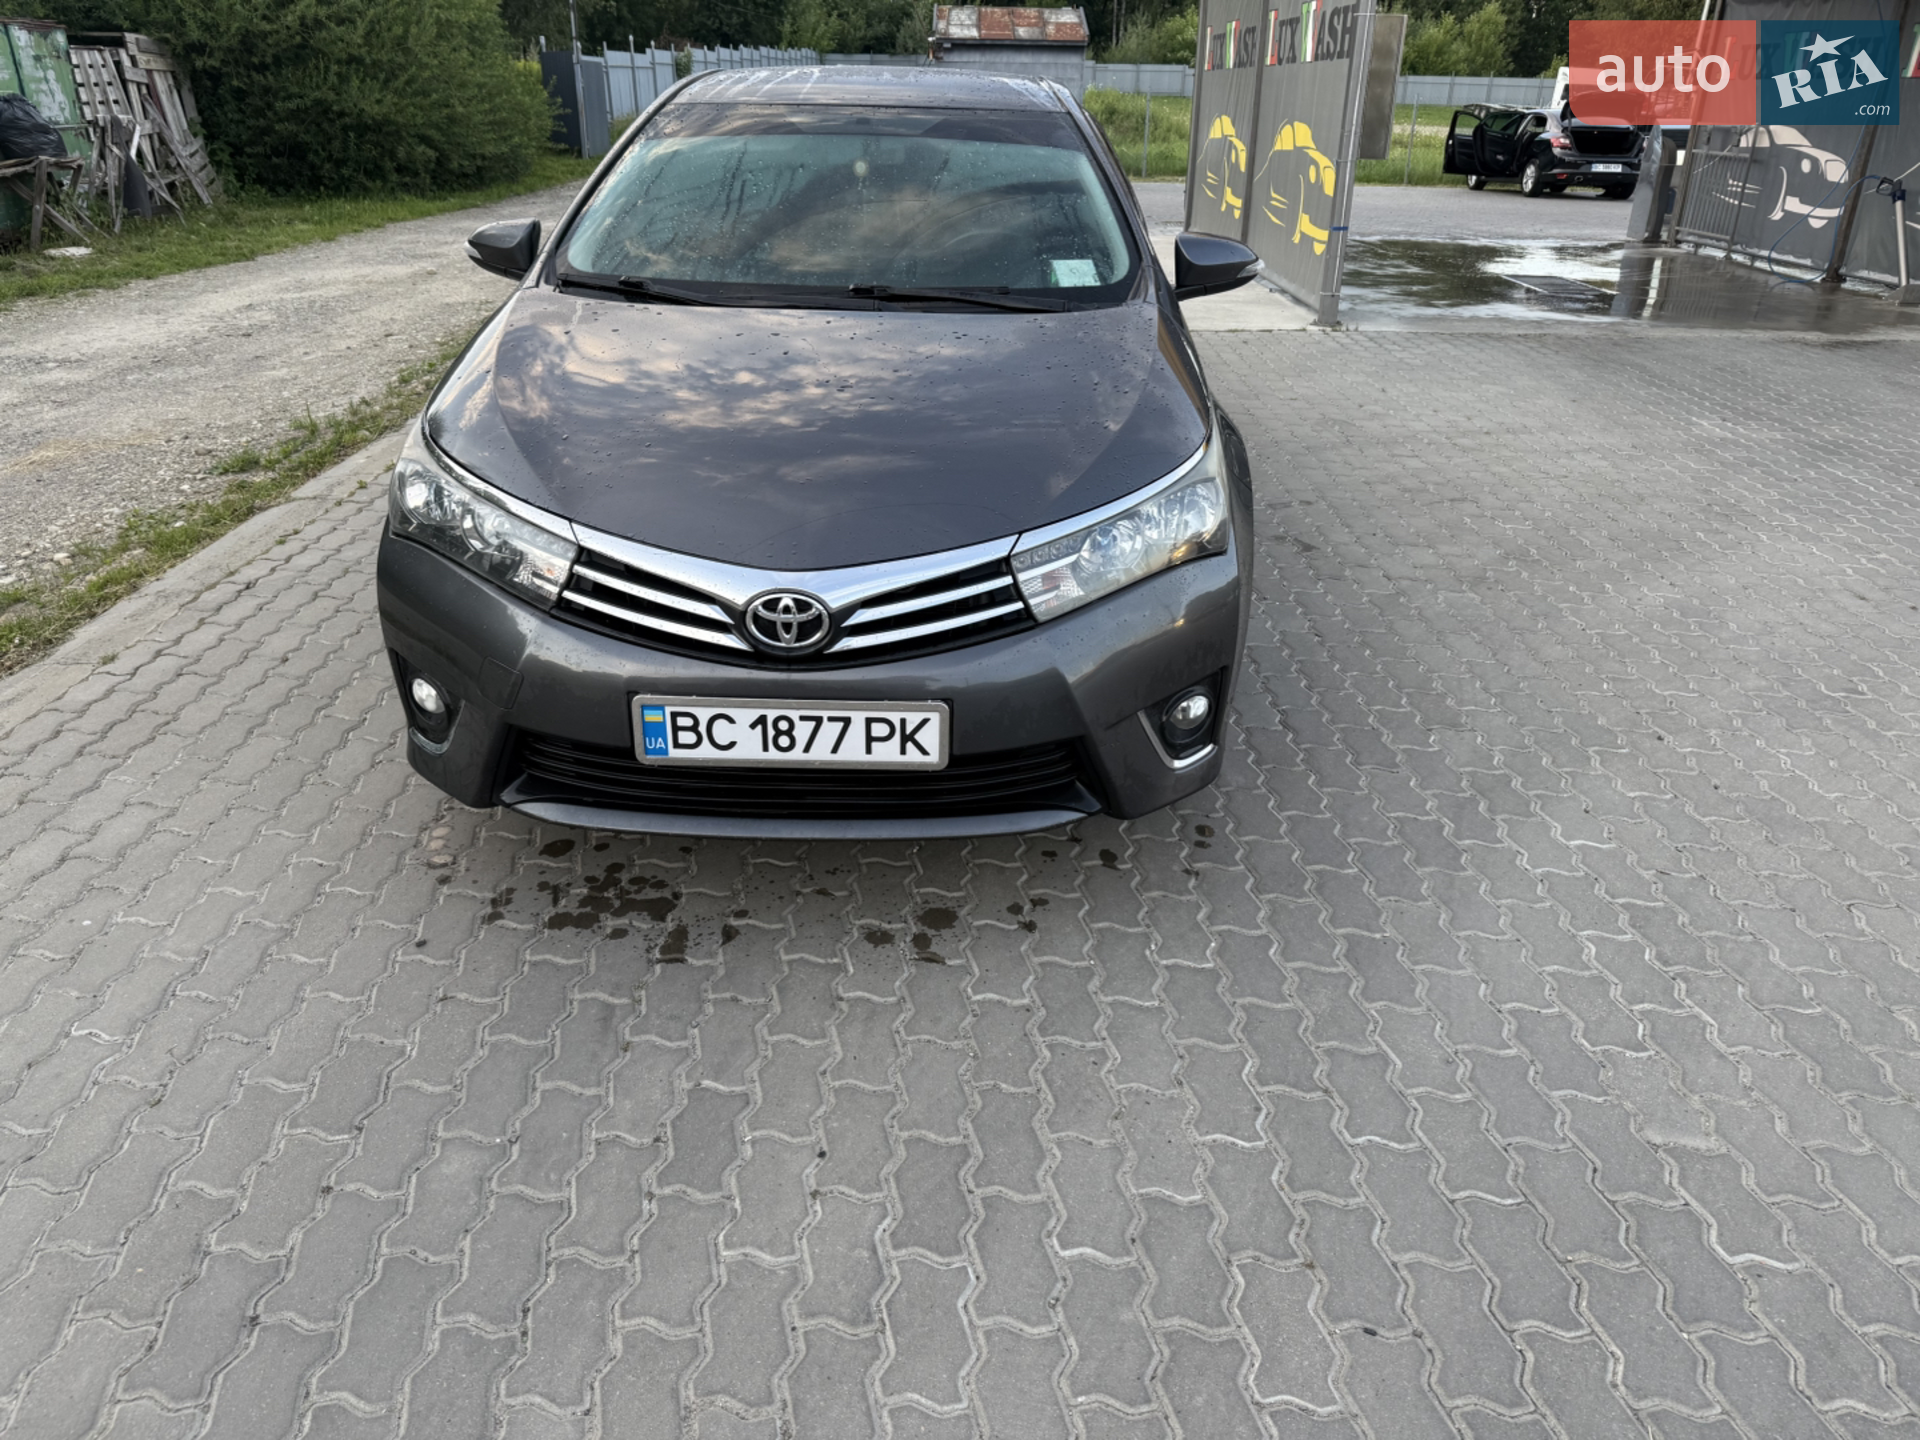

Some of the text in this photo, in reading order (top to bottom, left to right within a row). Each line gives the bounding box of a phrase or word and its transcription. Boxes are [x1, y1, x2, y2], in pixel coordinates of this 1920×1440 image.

[645, 736, 667, 750] UA
[670, 711, 931, 756] BC 1877 PK
